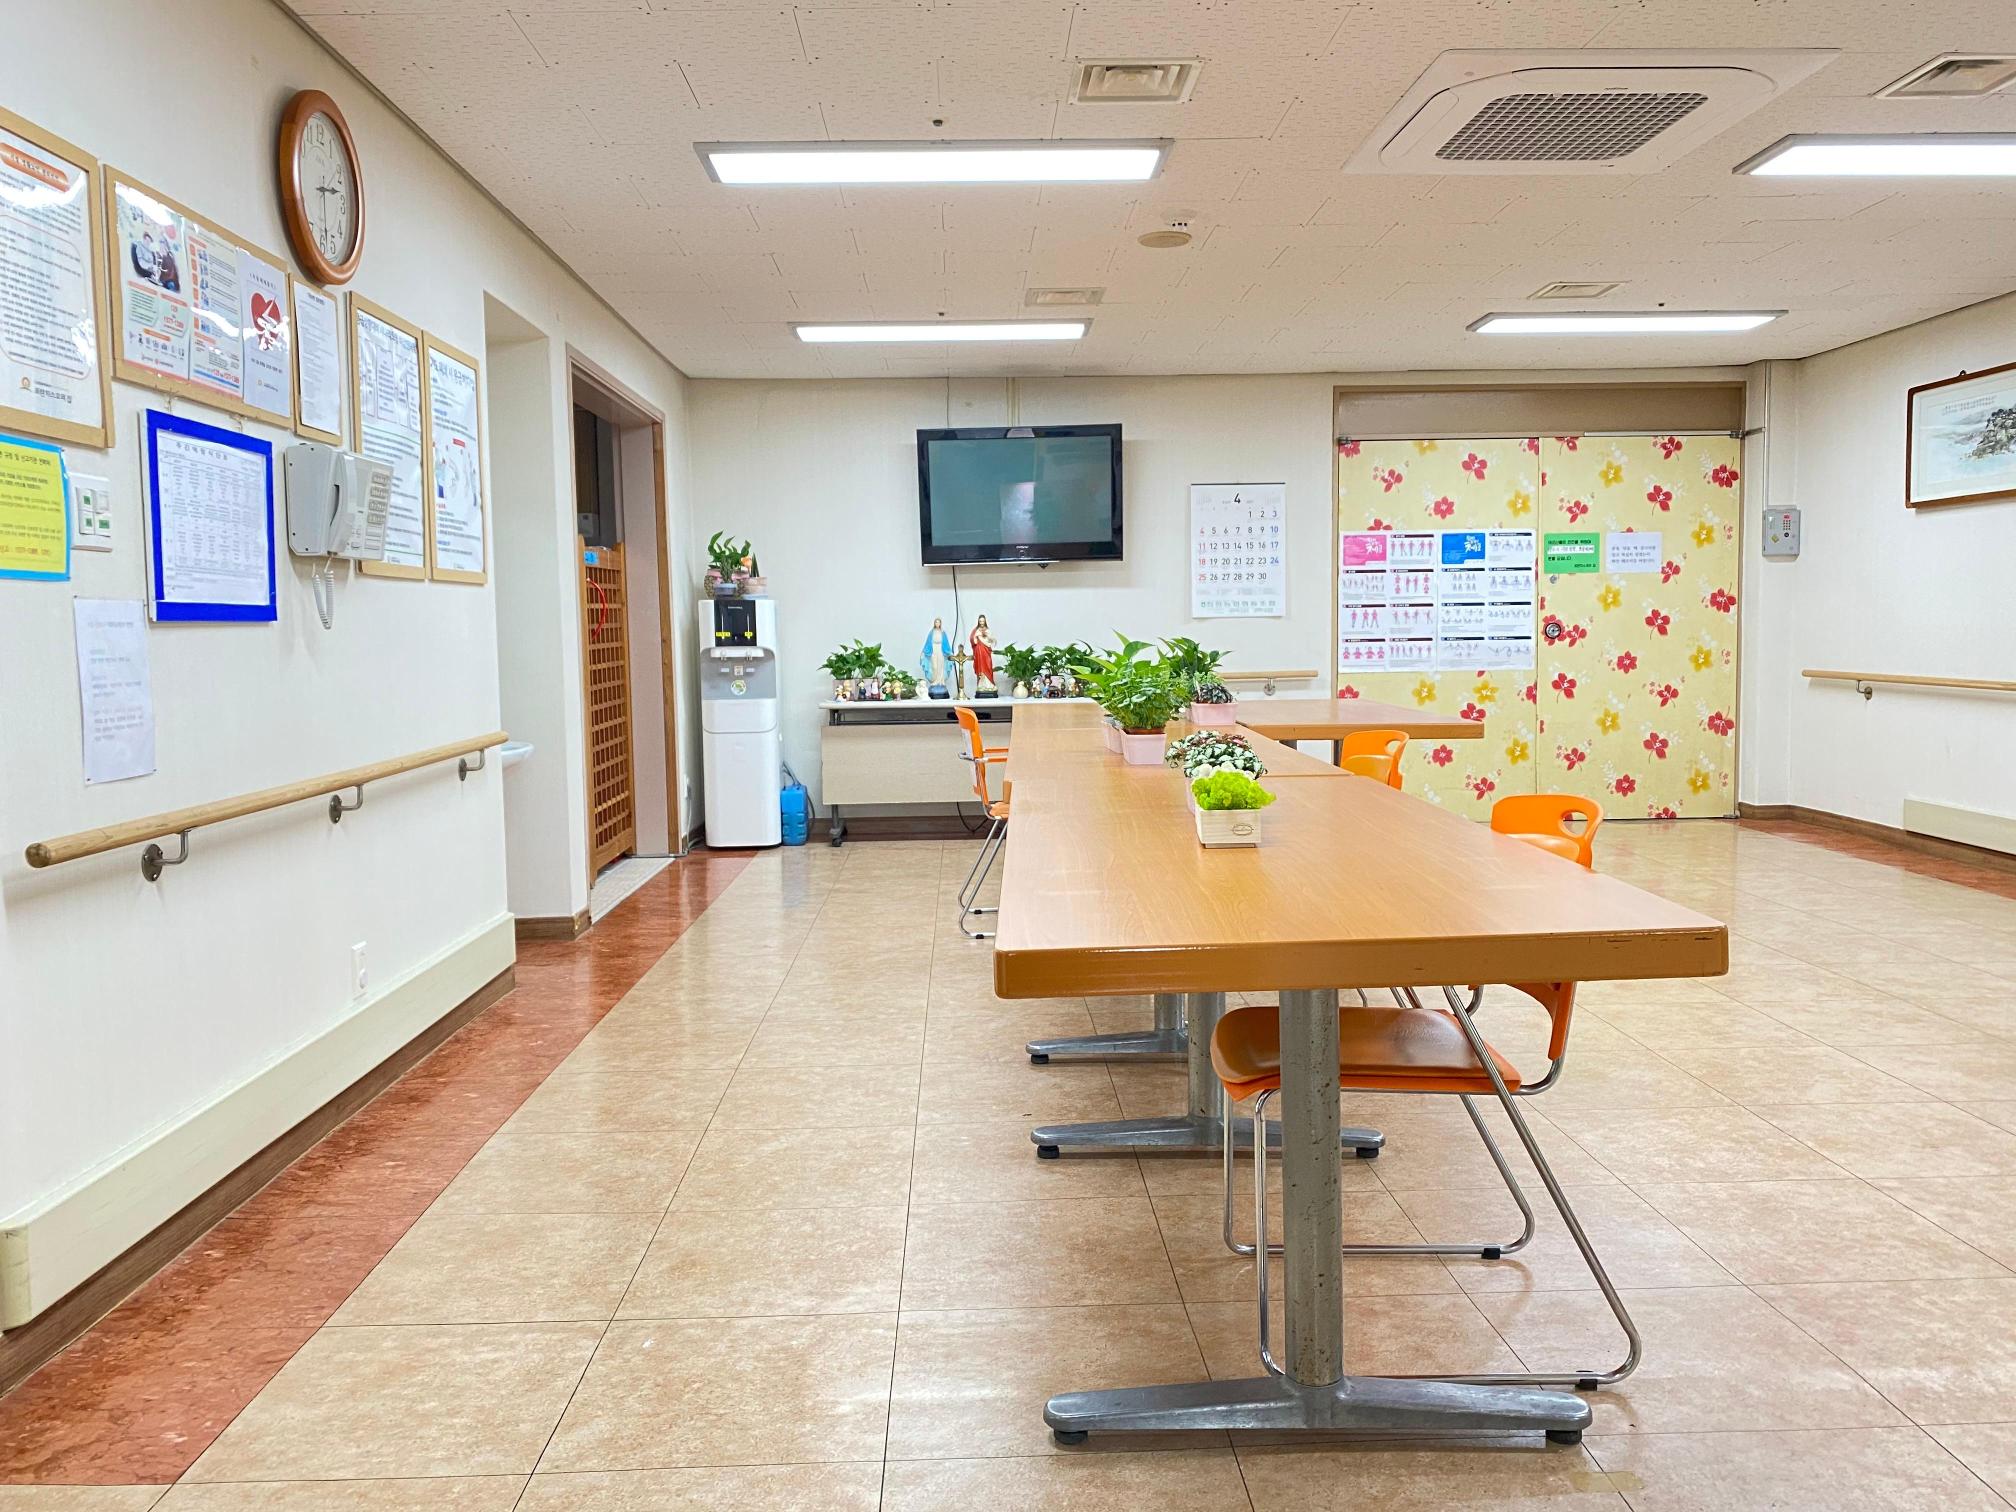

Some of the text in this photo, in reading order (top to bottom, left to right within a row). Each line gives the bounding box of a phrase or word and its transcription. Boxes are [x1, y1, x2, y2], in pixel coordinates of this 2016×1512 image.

[317, 123, 325, 146] 12
[336, 164, 343, 185] 2
[340, 195, 346, 215] 3
[337, 220, 343, 239] 4
[320, 235, 326, 256] 6
[330, 235, 336, 255] 5
[1234, 493, 1241, 504] 4
[1270, 525, 1279, 533] 10
[1210, 542, 1218, 550] 12
[1234, 557, 1242, 565] 21
[1246, 557, 1255, 565] 22
[1258, 557, 1267, 565] 23
[1270, 556, 1279, 564] 24
[1199, 573, 1206, 581] 25
[1258, 572, 1267, 580] 30
